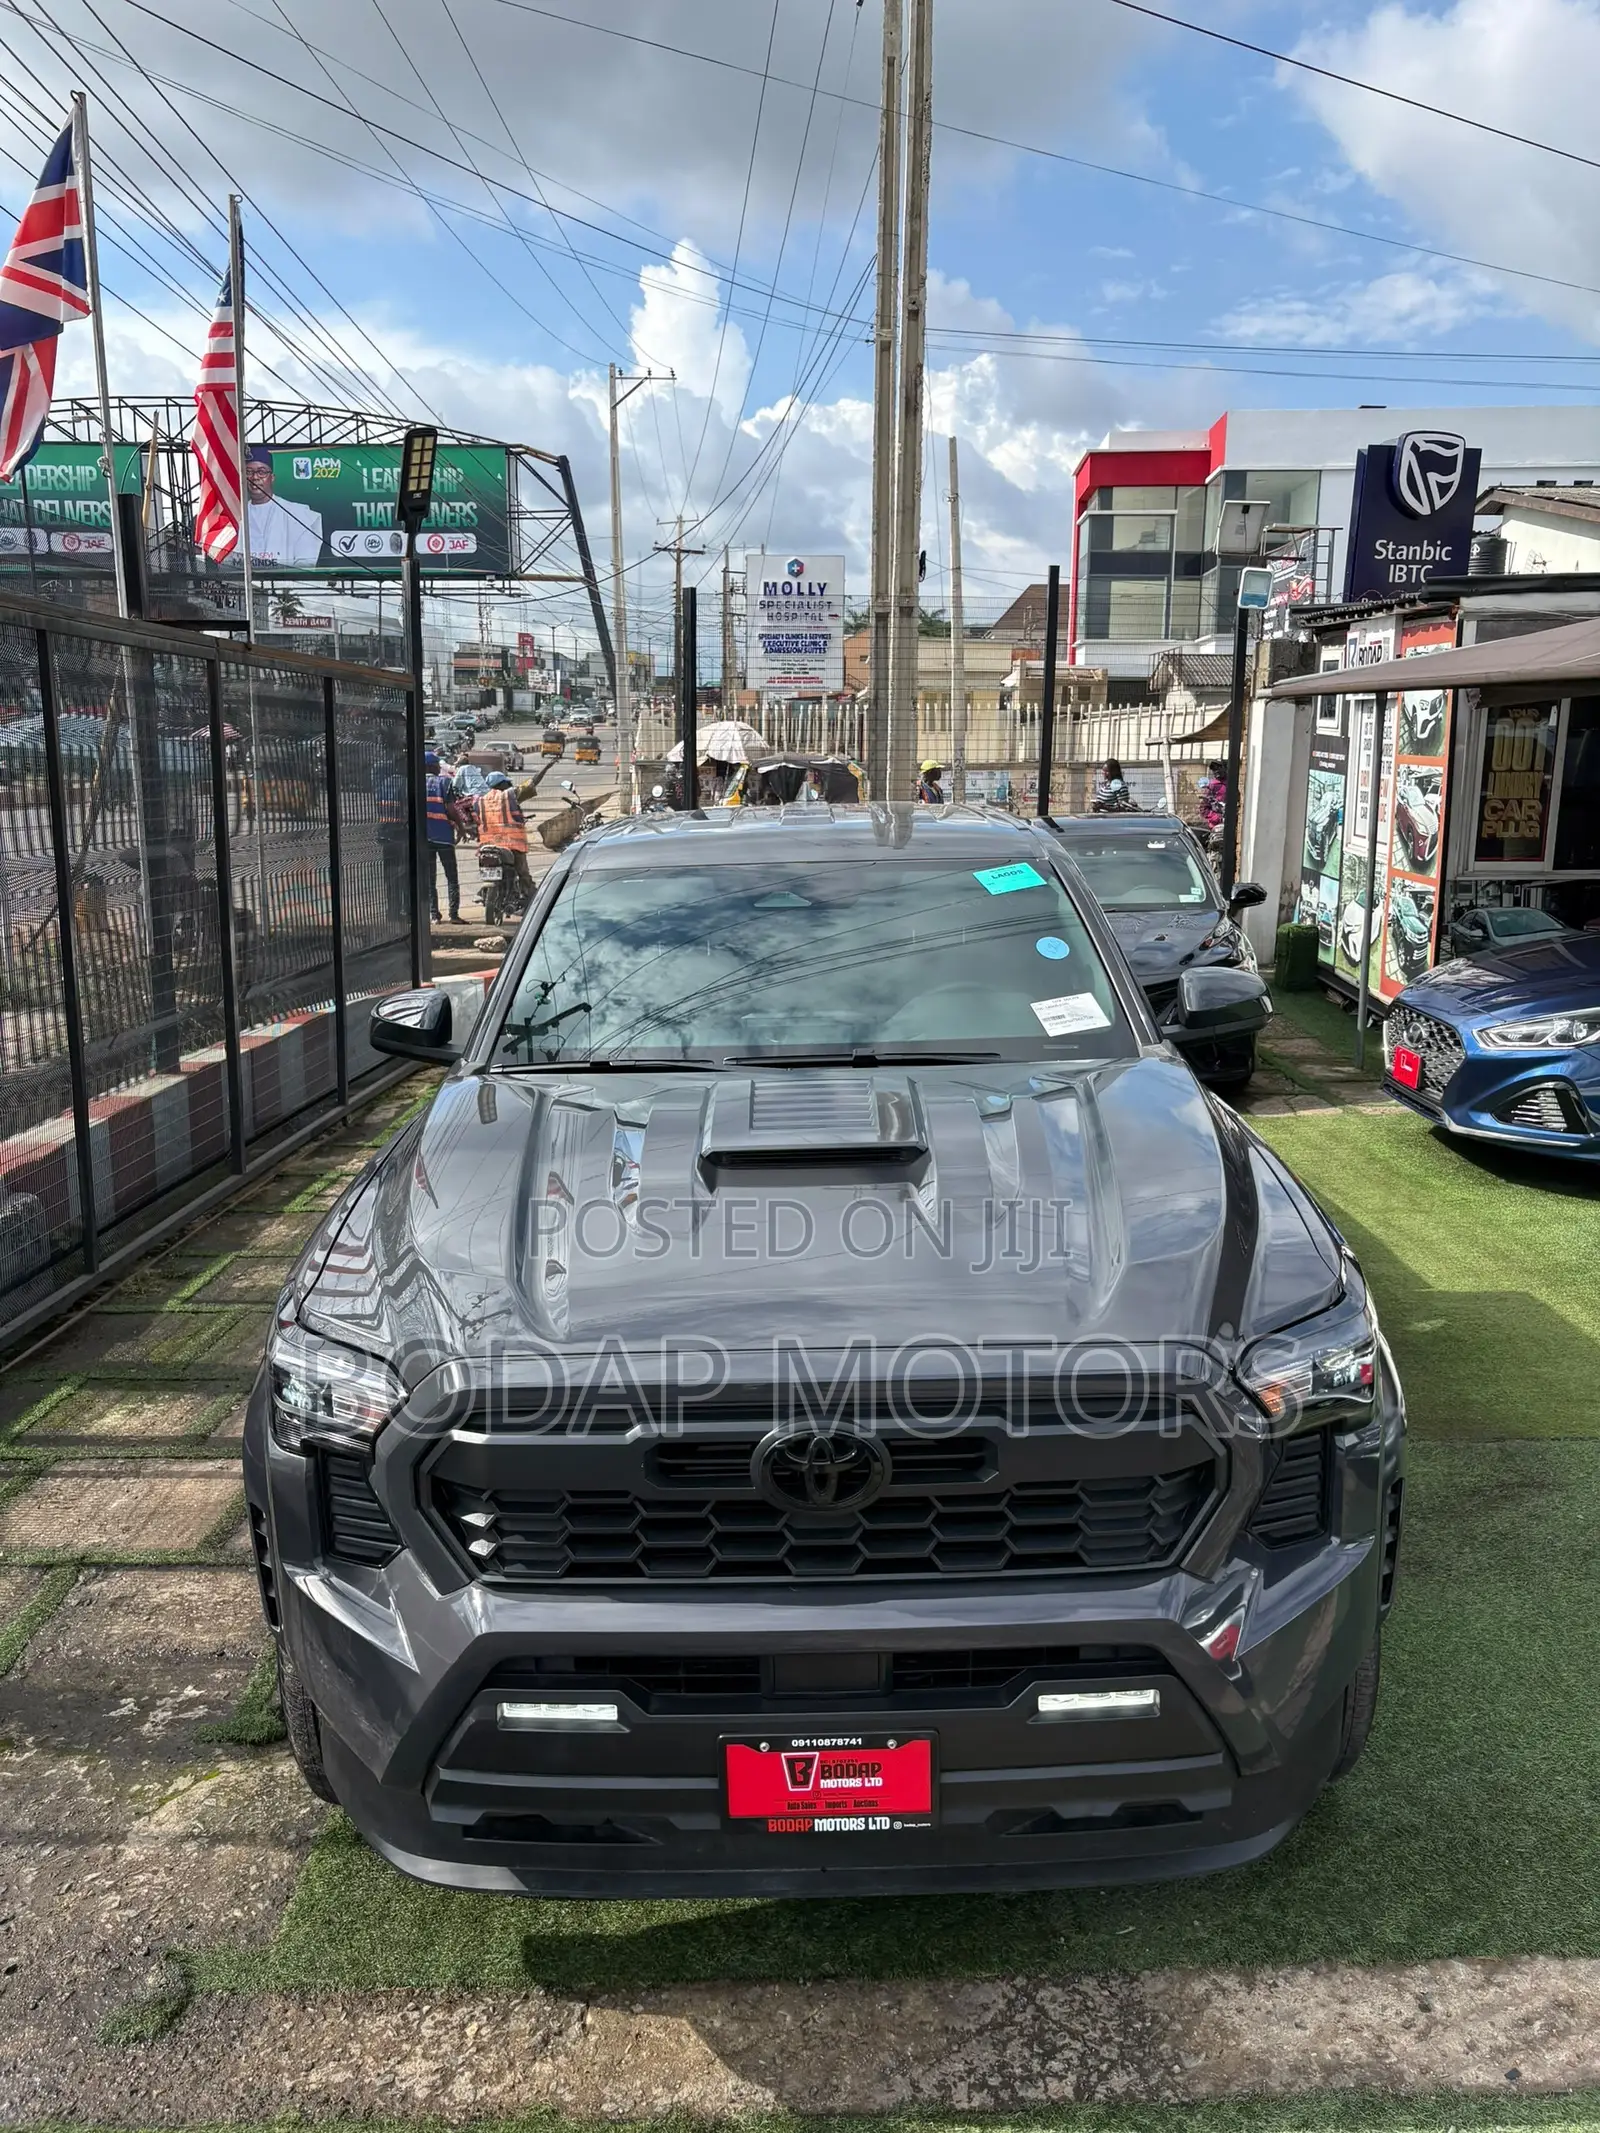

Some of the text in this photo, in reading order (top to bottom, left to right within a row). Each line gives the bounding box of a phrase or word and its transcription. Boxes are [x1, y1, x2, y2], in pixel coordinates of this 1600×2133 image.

[313, 458, 341, 468] APM
[313, 467, 341, 478] 2027
[352, 502, 395, 527] THAT
[449, 539, 469, 549] JAF
[1374, 539, 1453, 561] Stanbic
[1388, 563, 1434, 583] IBTC
[763, 581, 828, 596] MOLLY
[759, 600, 833, 610] SPECIALIST
[767, 612, 824, 622] HOSPITAL
[763, 640, 799, 648] EXECUTIVE
[1483, 799, 1542, 820] CAR
[1481, 821, 1540, 838] PLUG
[991, 869, 1025, 880] LAGOS
[792, 1738, 862, 1747] 09110878741
[820, 1762, 882, 1779] BODAP
[820, 1777, 883, 1789] MOTORS LTD
[767, 1816, 890, 1833] BODAP MOTORS LTD
